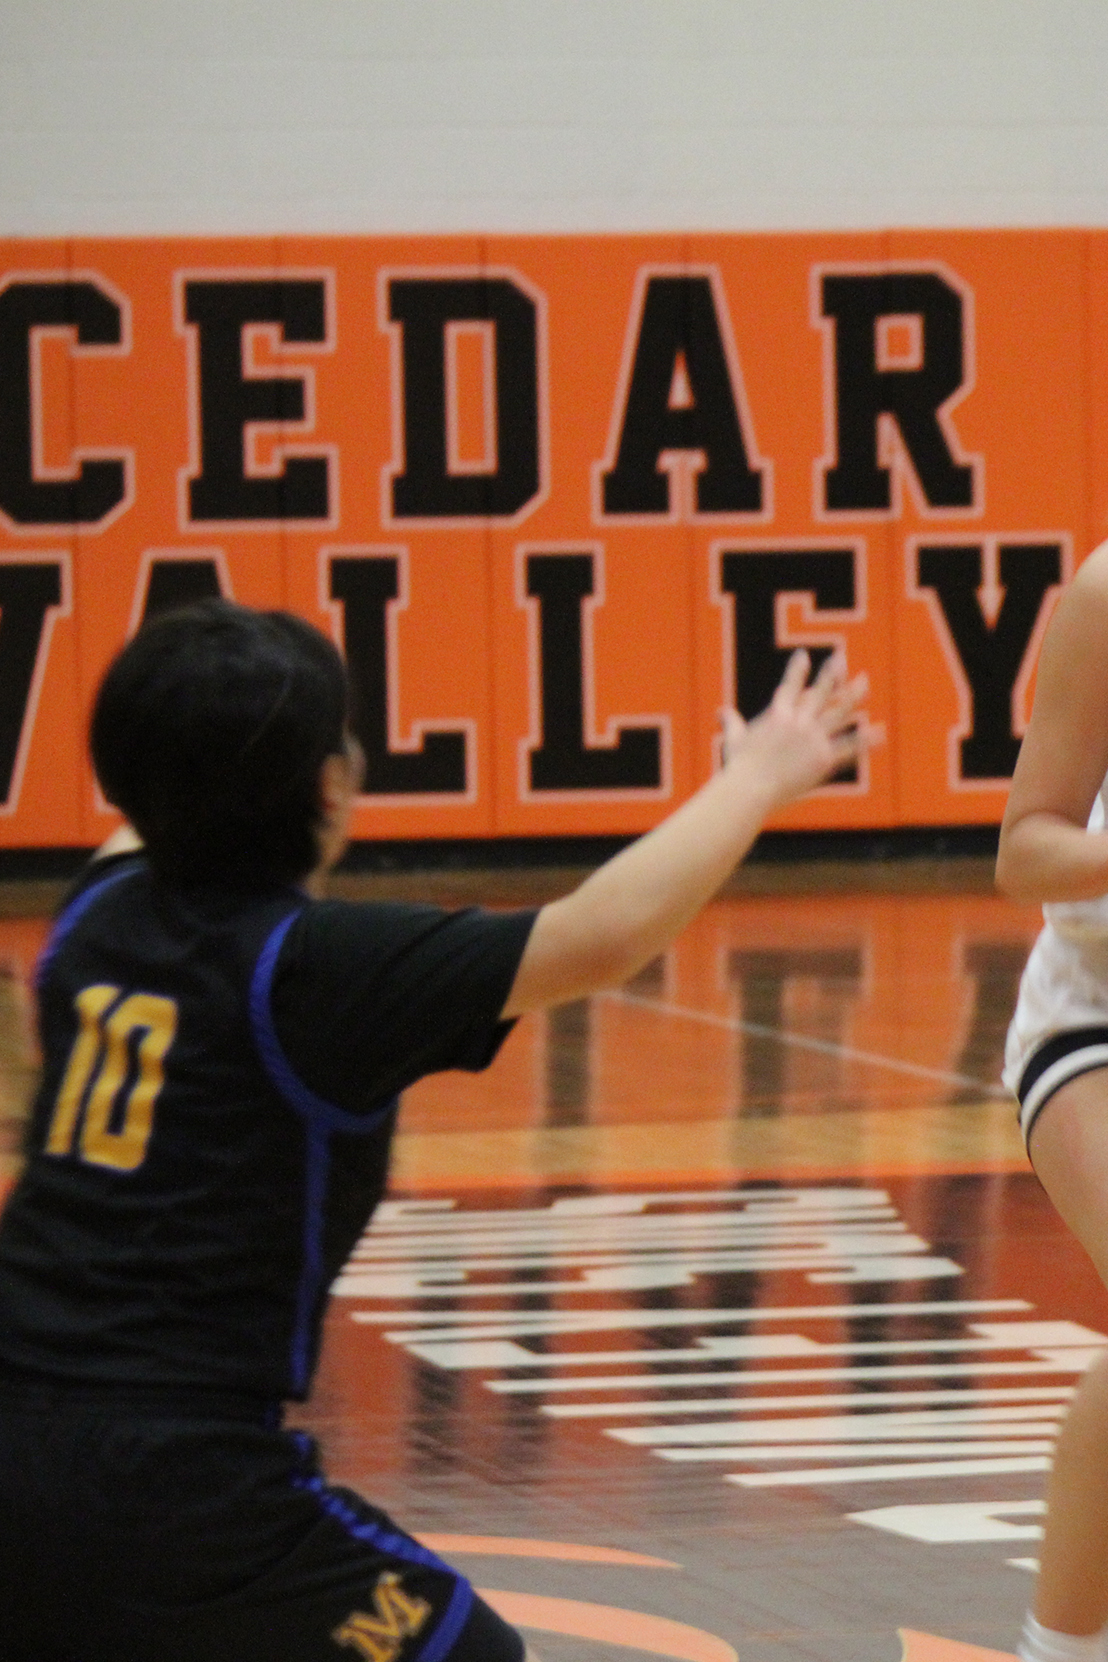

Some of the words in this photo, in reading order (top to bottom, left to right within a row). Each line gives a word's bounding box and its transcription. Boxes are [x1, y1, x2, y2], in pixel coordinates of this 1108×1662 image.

[0, 262, 986, 533] CEDAR
[0, 532, 1073, 813] LLEY
[46, 983, 178, 1170] 10
[332, 1571, 431, 1662] M
